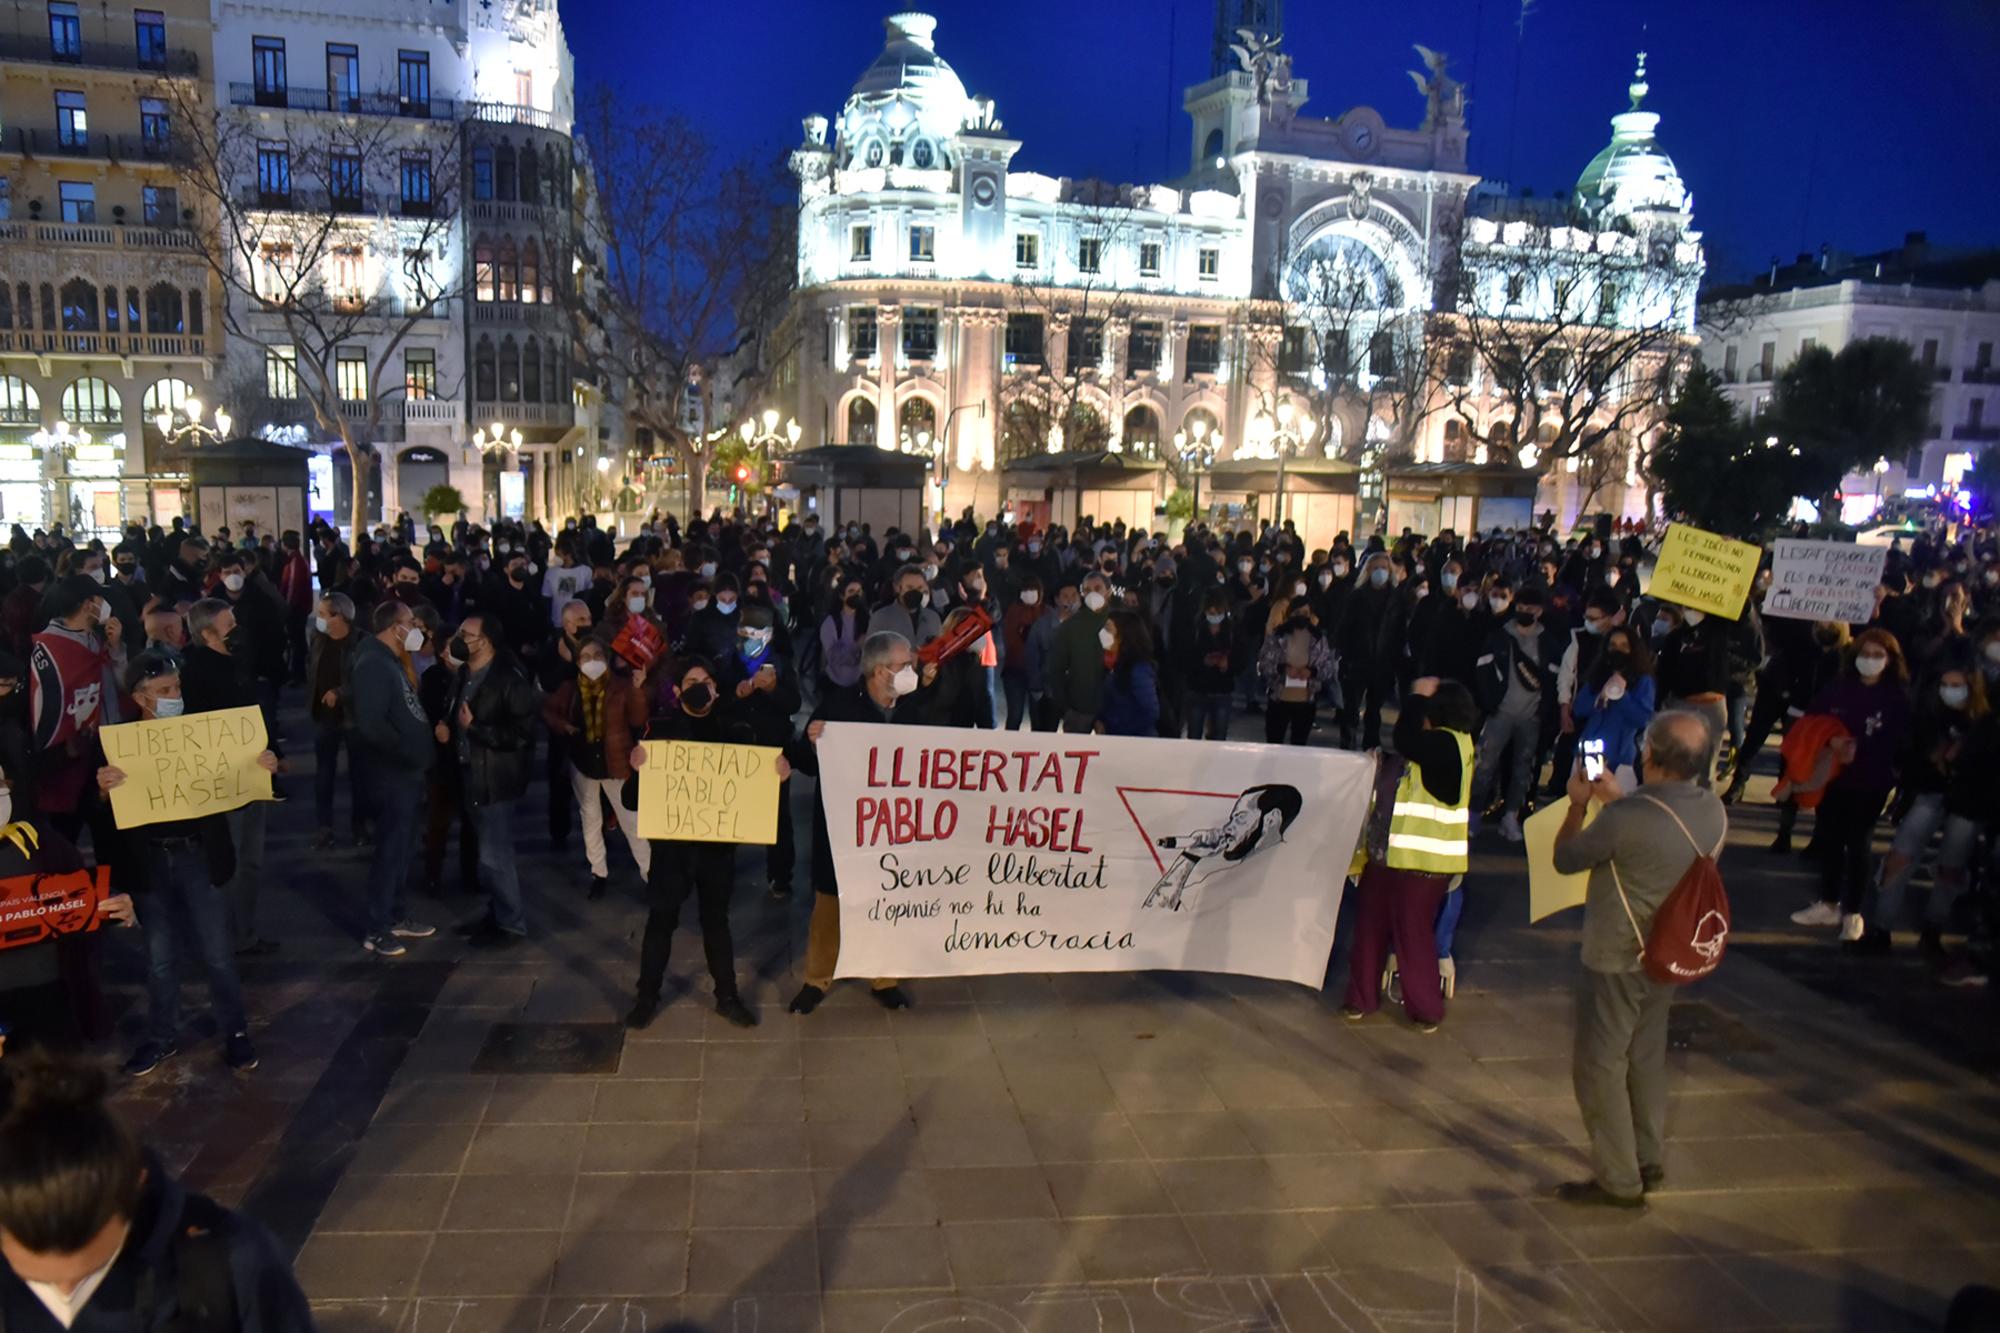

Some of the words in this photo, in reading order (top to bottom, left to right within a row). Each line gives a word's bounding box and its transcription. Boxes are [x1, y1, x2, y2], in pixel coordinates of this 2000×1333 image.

[155, 751, 231, 783] PARA
[665, 773, 738, 806] PABLO
[664, 804, 745, 840] HASEL
[856, 797, 958, 848] PABLO
[985, 804, 1093, 854] HASEL
[879, 852, 971, 892] Sense
[6, 907, 46, 922] PABLO
[49, 899, 87, 914] HASEL
[868, 898, 941, 927] d'opinió
[949, 899, 974, 915] no
[985, 891, 1005, 916] hi
[1016, 891, 1042, 917] ha
[944, 919, 1136, 953] democracia
